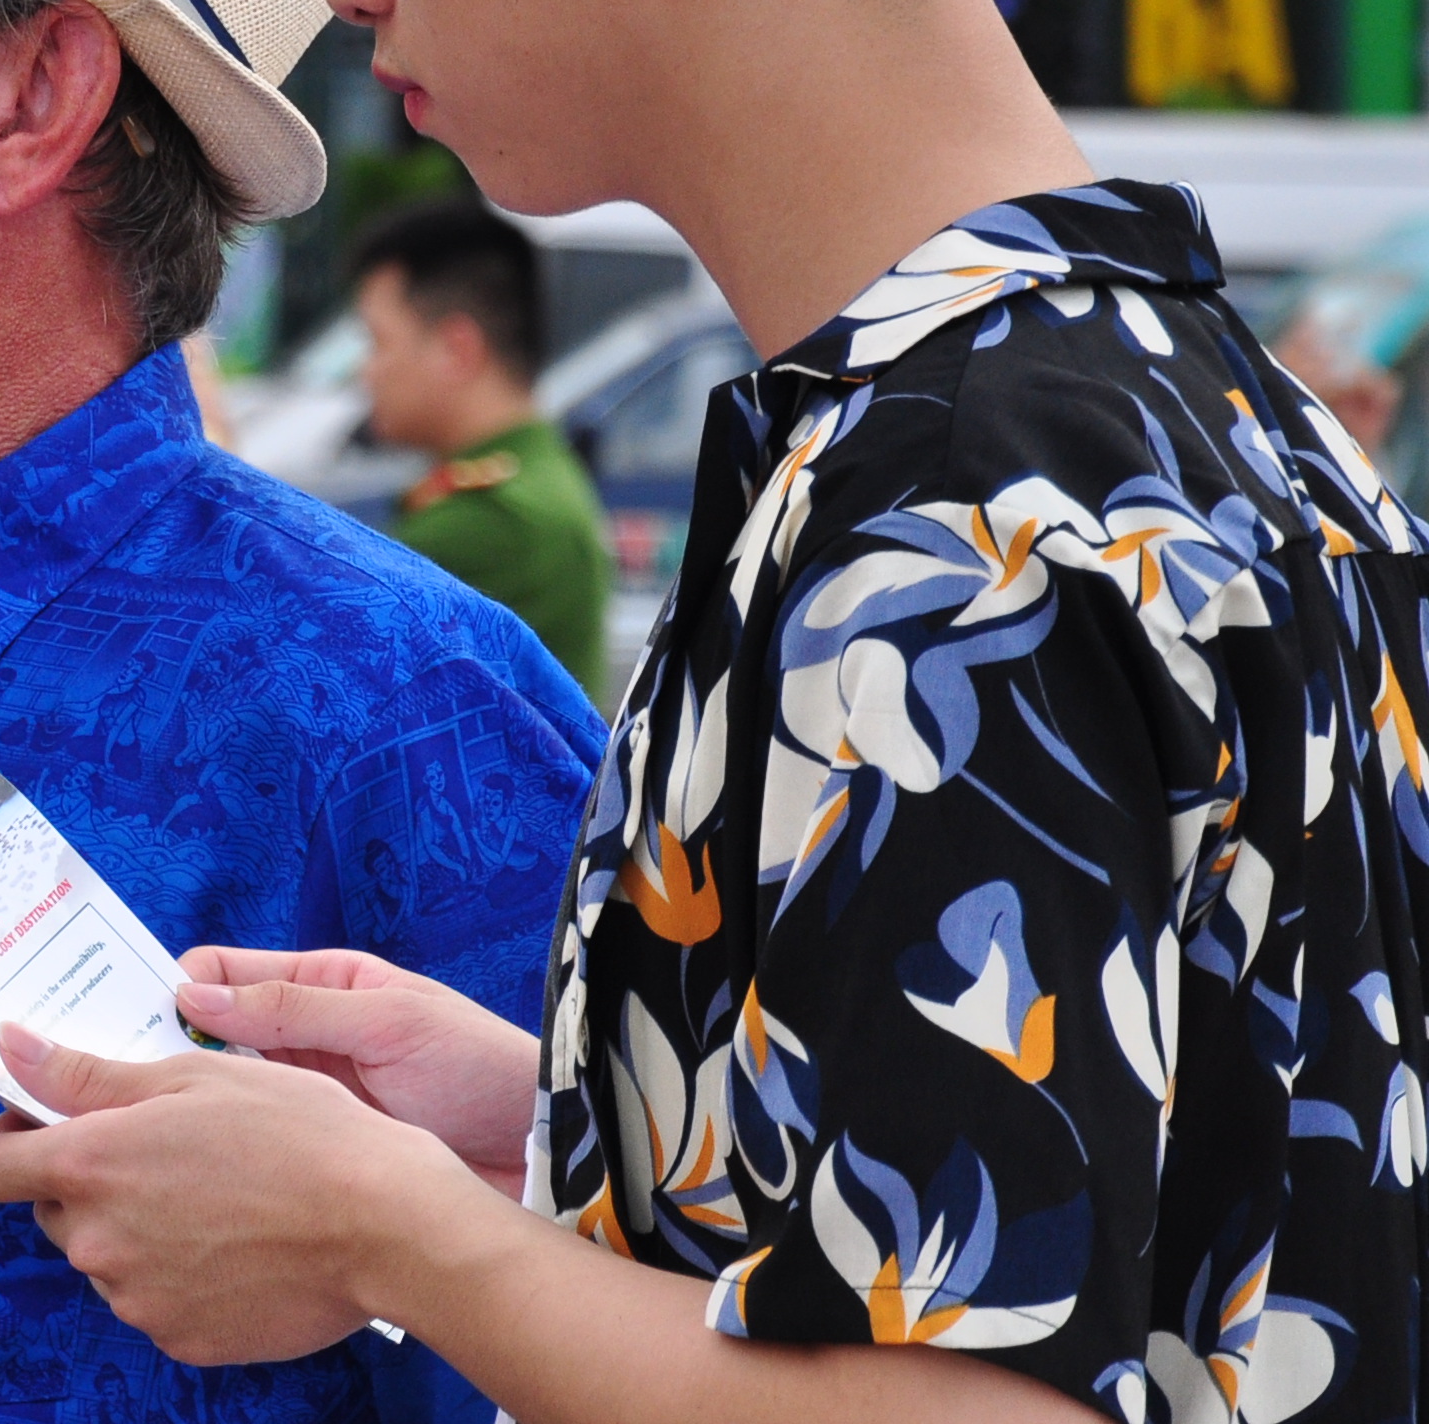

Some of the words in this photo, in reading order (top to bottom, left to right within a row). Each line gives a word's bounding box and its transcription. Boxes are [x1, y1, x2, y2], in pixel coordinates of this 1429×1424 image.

[14, 878, 74, 937] DESTINATION
[47, 984, 60, 997] the
[80, 963, 113, 999] producers
